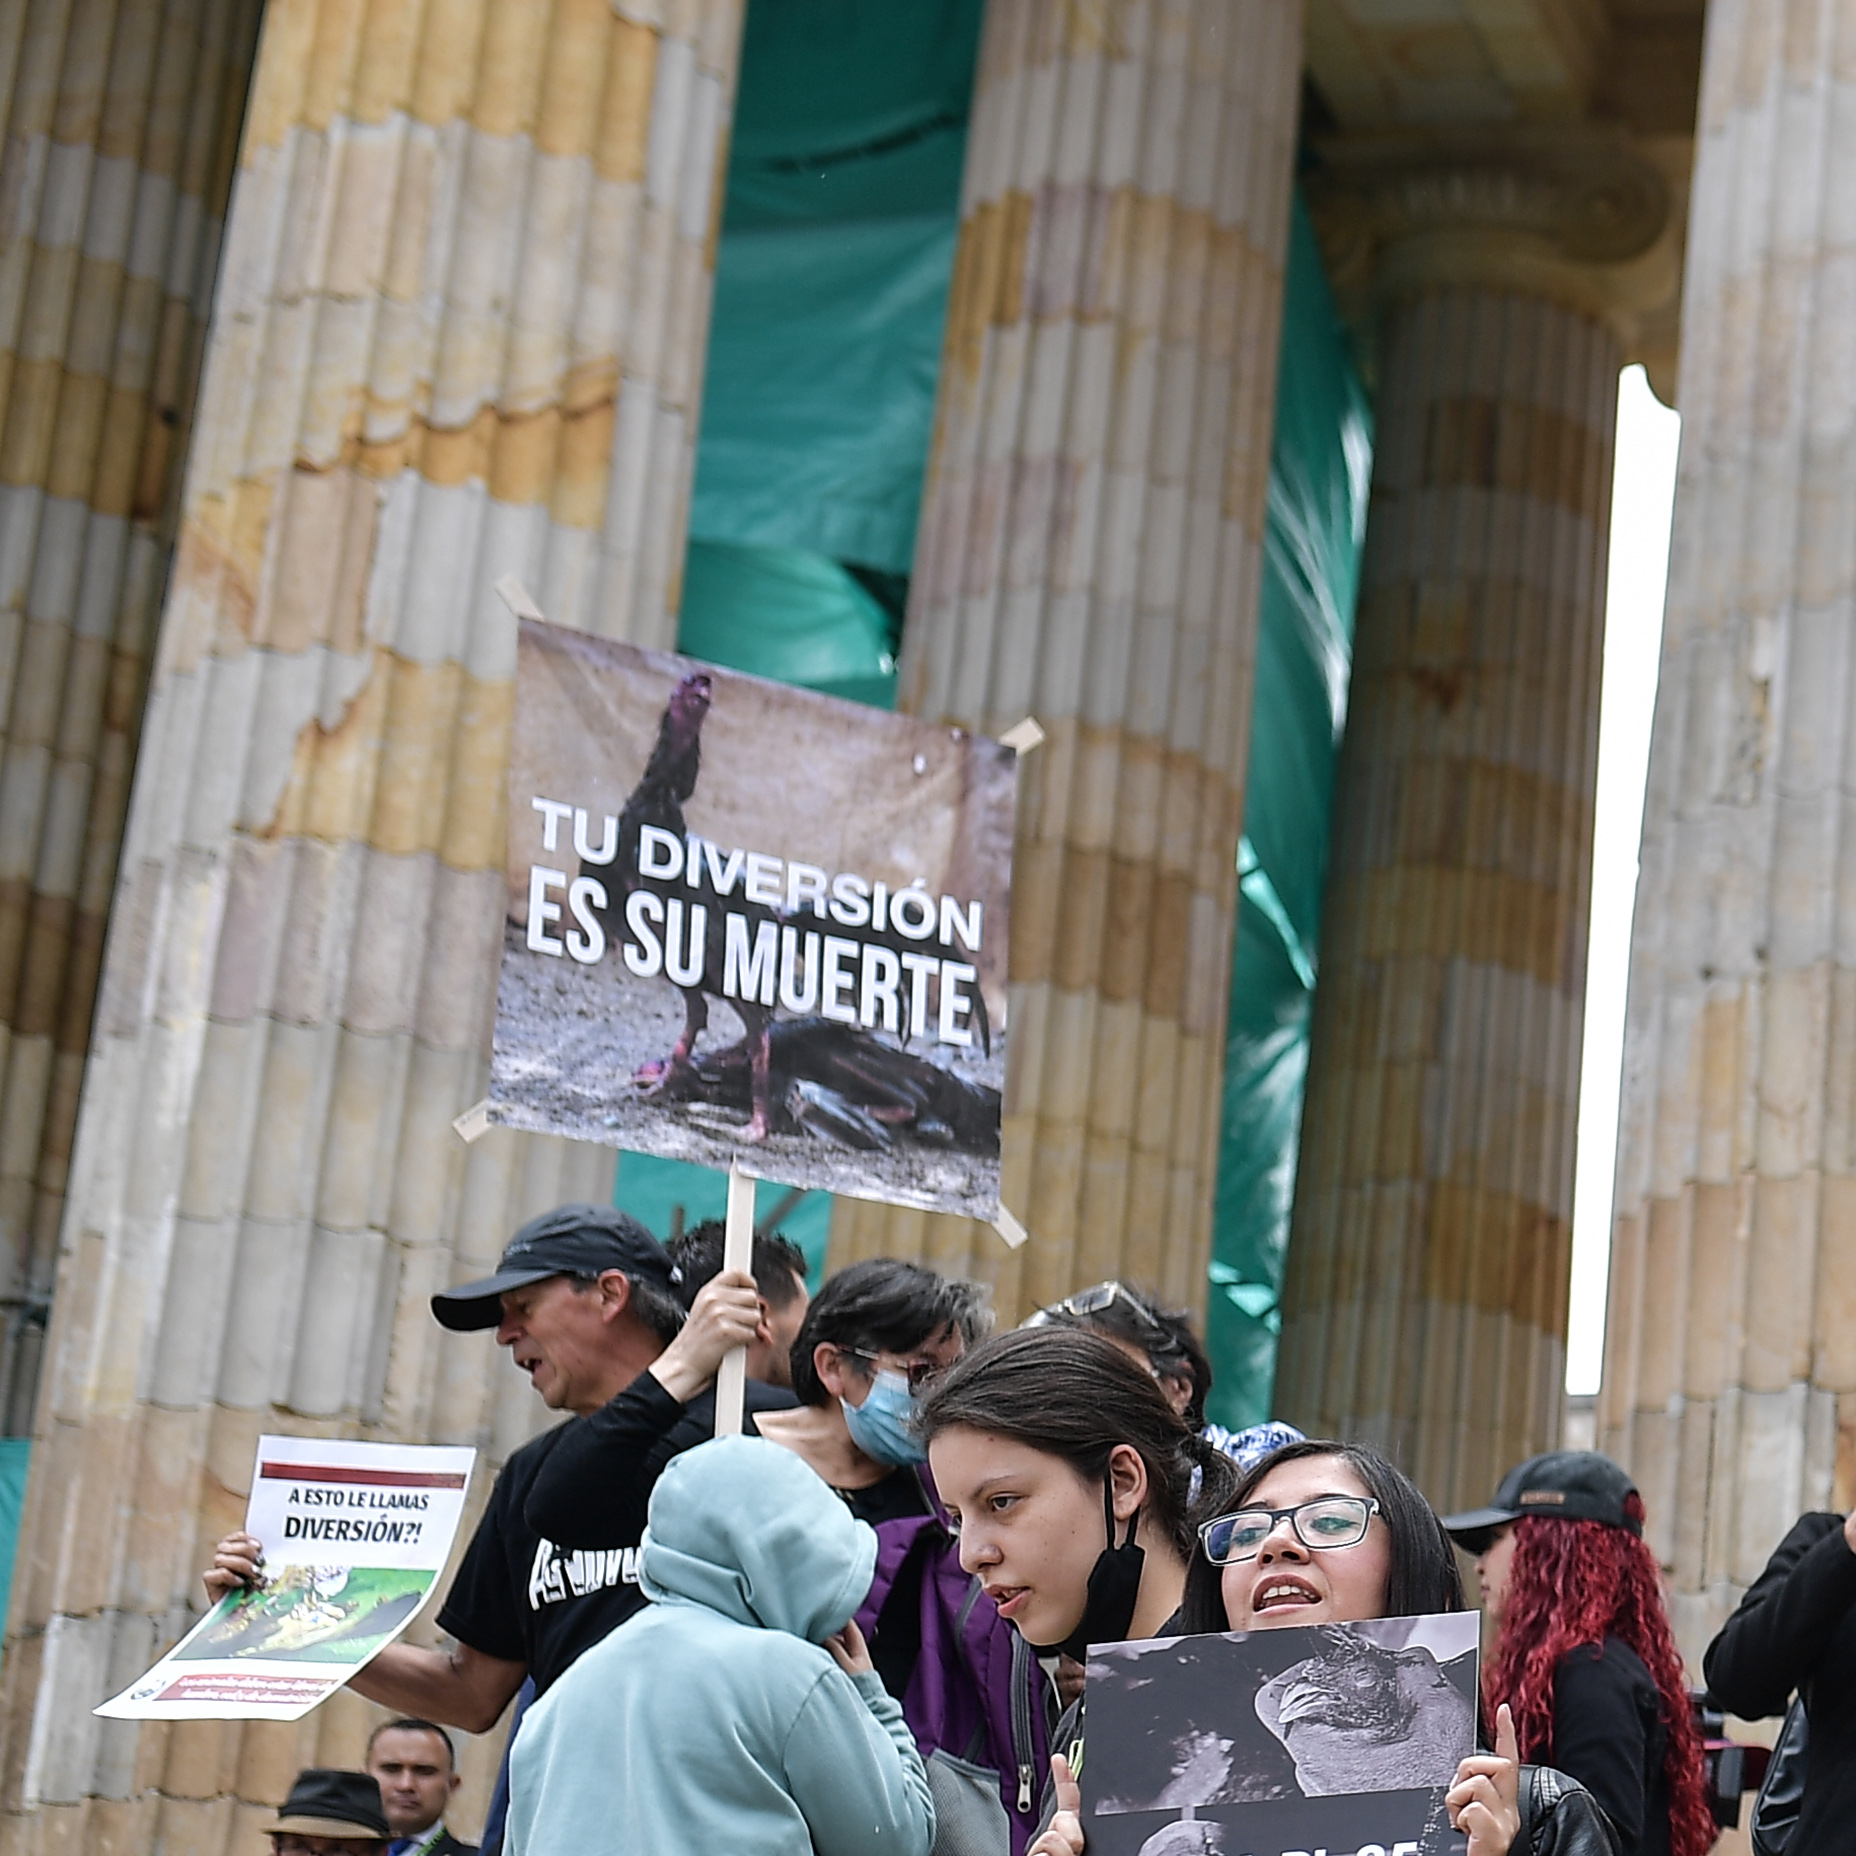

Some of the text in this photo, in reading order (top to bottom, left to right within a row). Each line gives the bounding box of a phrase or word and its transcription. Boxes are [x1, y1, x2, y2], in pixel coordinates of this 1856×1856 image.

[531, 796, 982, 952] TU DIVERSIÓN
[526, 865, 977, 1047] ES SU MUERTE
[284, 1513, 423, 1544] DIVERSIÓN?!
[289, 1488, 430, 1511] A ESTO LE LLAMAS
